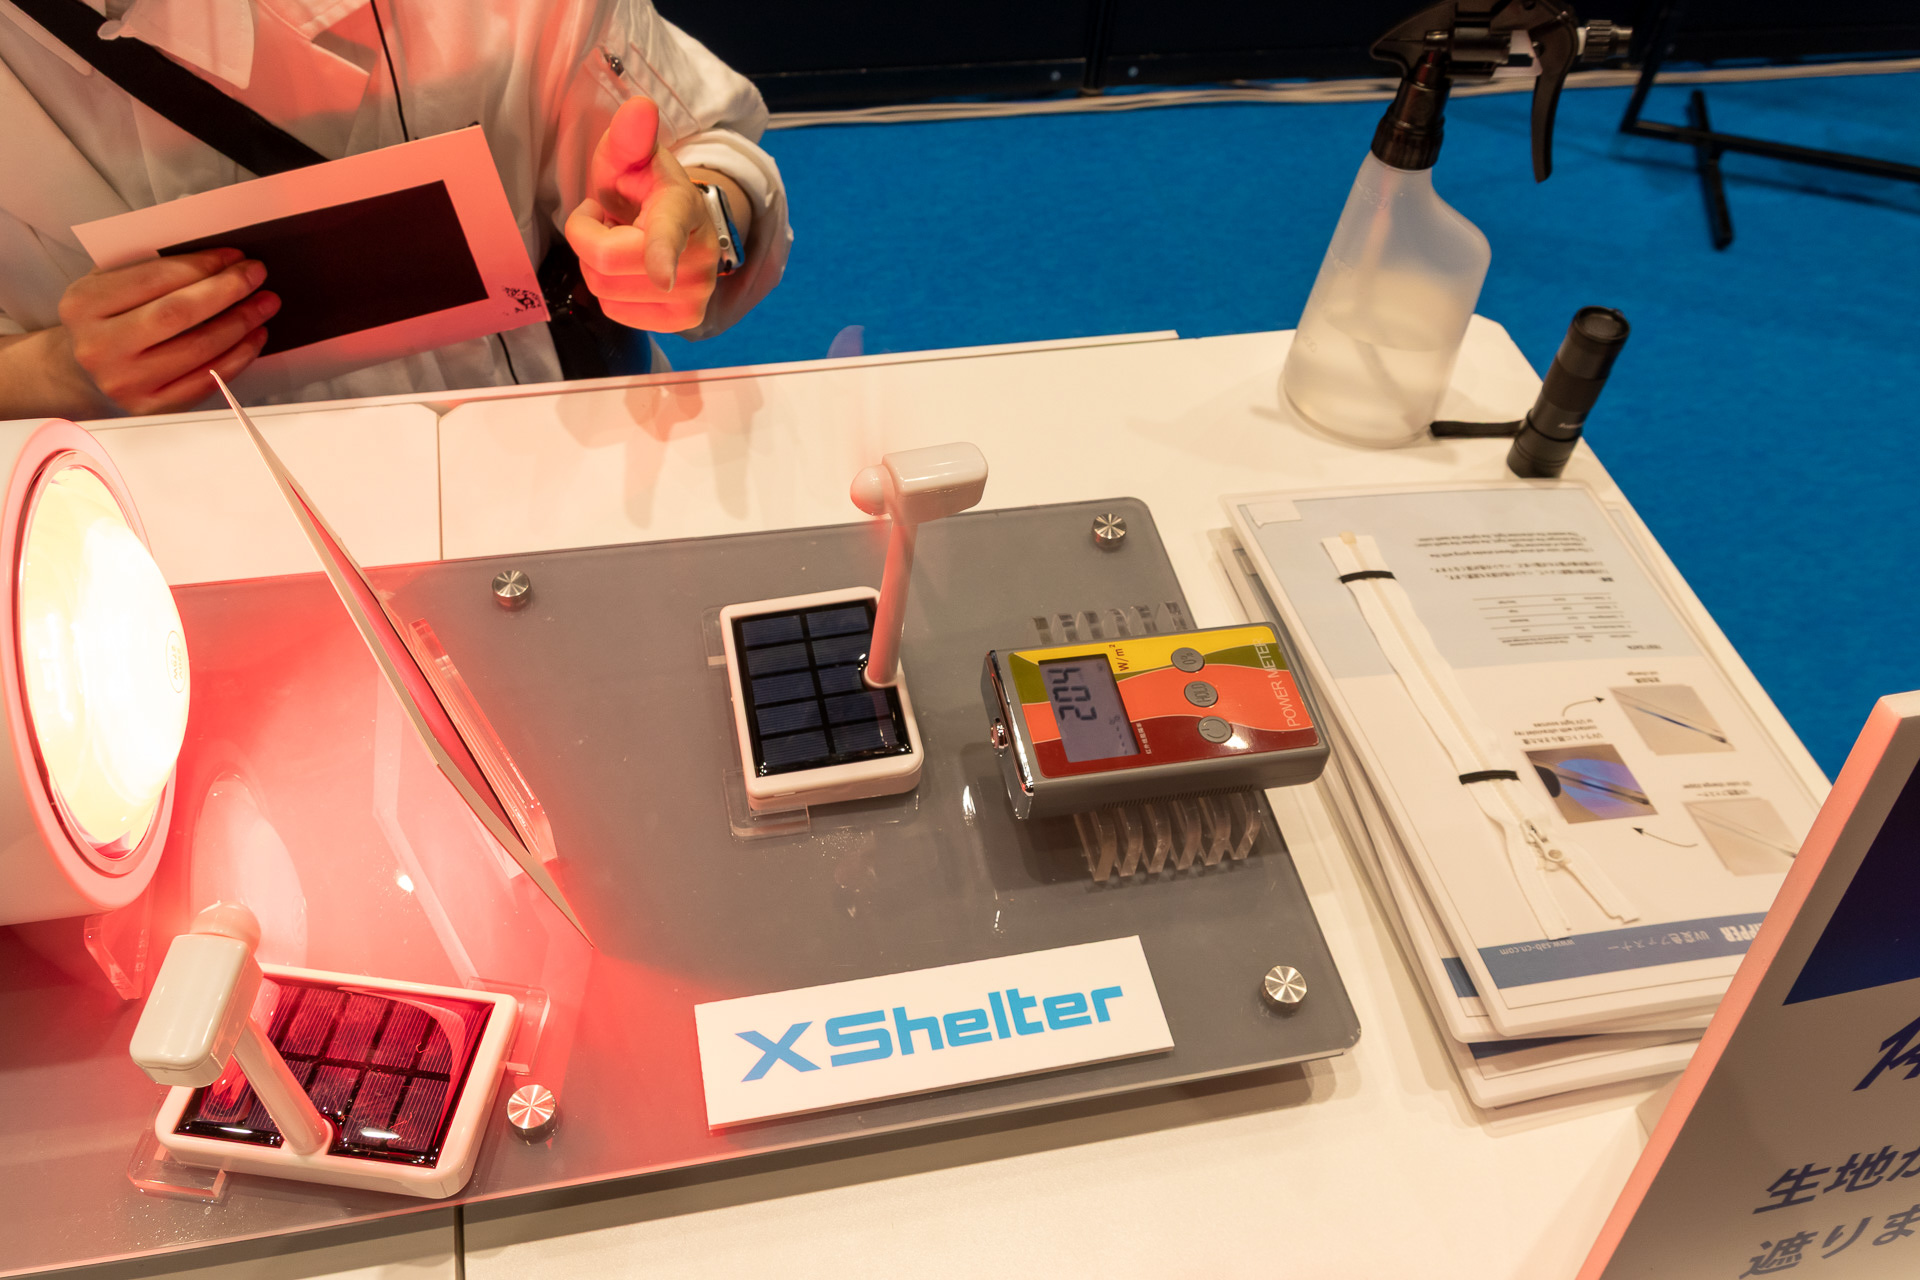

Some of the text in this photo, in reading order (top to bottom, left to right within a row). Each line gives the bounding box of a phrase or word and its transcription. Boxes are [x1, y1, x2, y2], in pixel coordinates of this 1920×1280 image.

[1047, 667, 1097, 721] 204
[1191, 684, 1211, 703] HOLD
[1252, 638, 1301, 727] POWER METER
[1498, 939, 1576, 956] www.sab-cn.com
[735, 985, 1124, 1082] X Shelter
